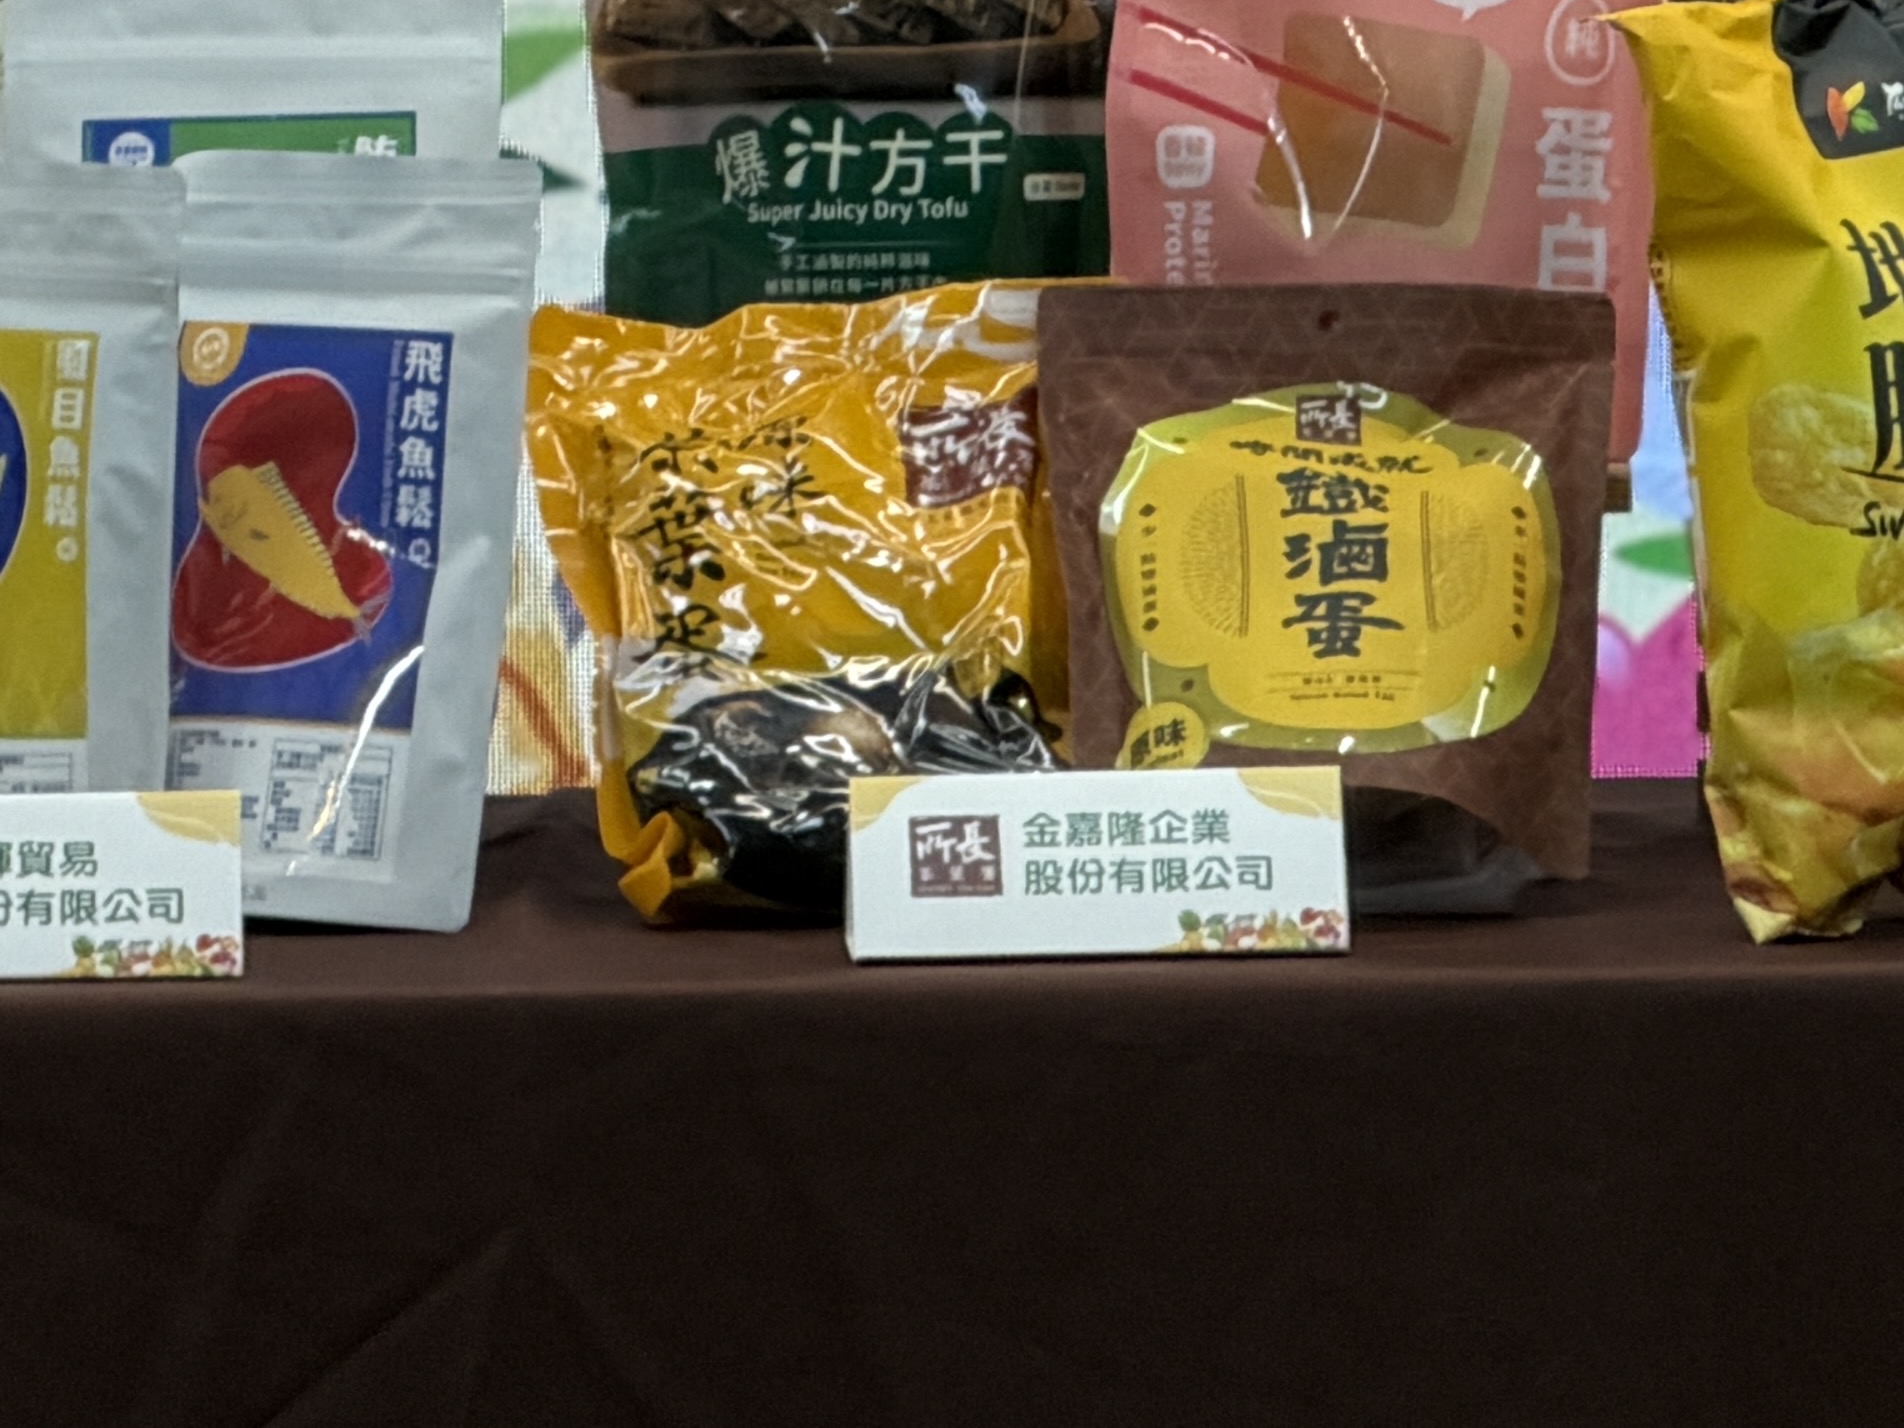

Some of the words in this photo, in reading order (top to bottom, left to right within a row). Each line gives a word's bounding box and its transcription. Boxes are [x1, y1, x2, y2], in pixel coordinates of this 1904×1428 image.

[715, 115, 1008, 204] 爆汁方干
[747, 200, 800, 226] Super
[808, 198, 868, 225] Juicy
[873, 198, 913, 226] Dry
[917, 196, 969, 219] Tofu
[396, 340, 443, 529] 飛虎魚鬆
[1021, 808, 1231, 848] 金嘉隆企業
[1023, 853, 1274, 897] 股份有限公司
[0, 887, 185, 927] 有限公司
